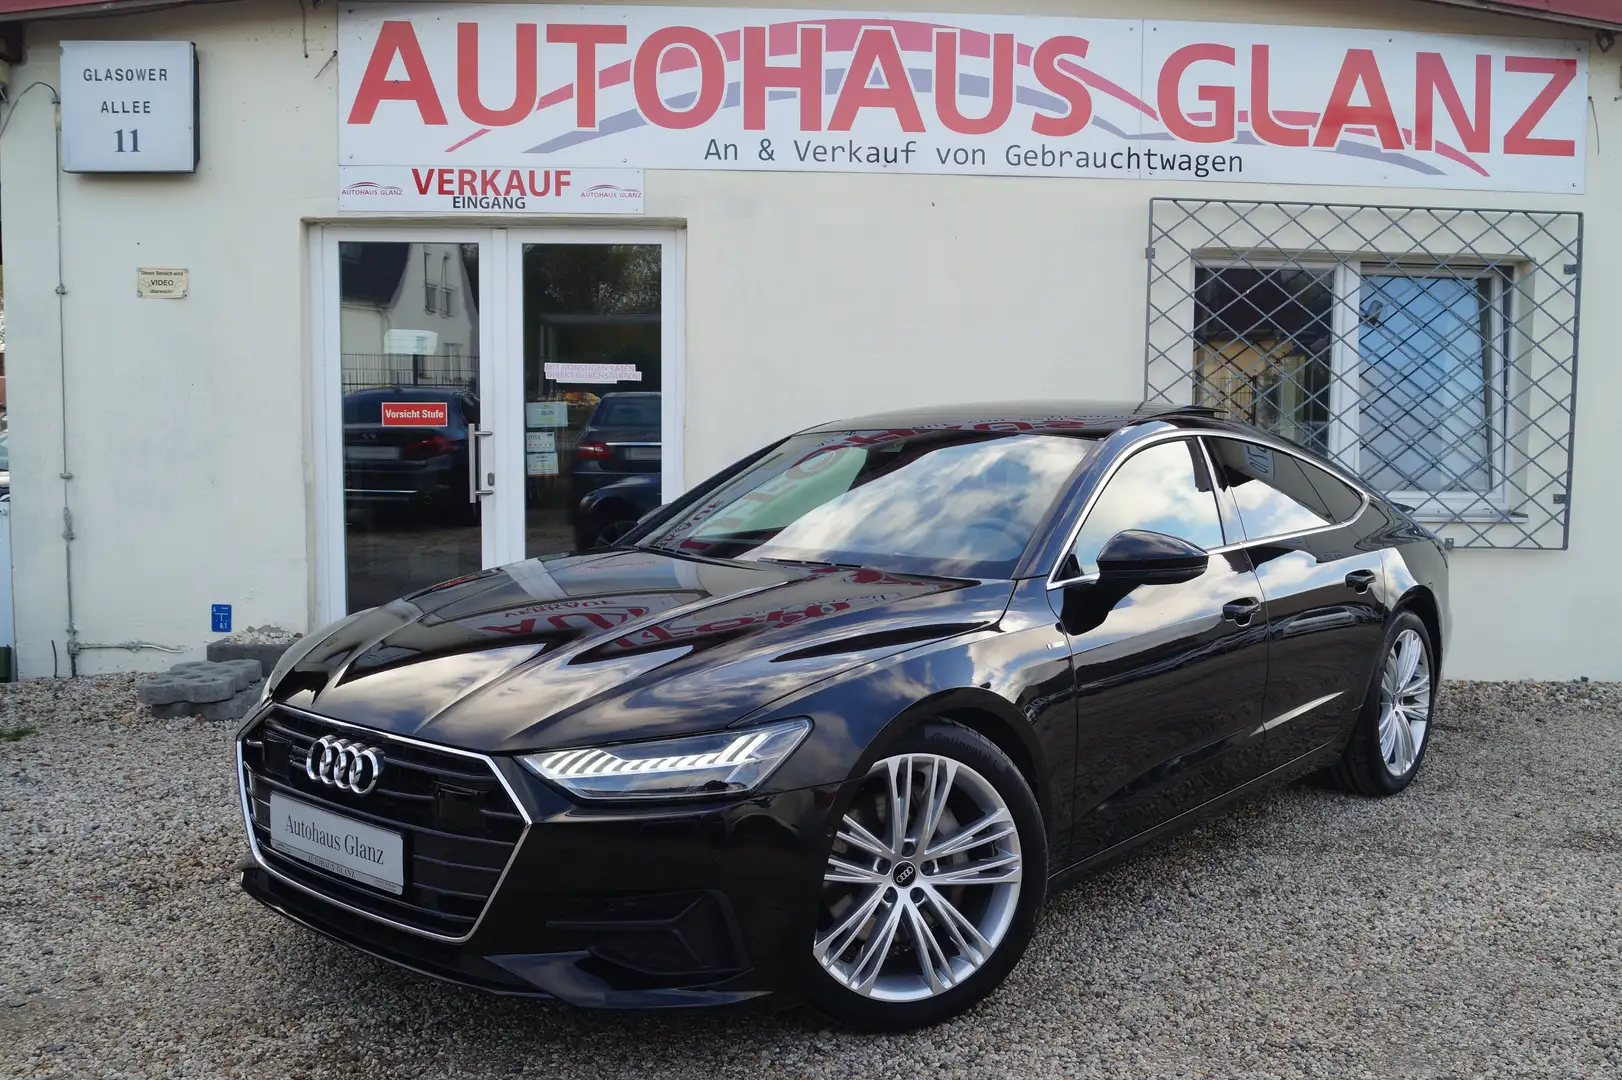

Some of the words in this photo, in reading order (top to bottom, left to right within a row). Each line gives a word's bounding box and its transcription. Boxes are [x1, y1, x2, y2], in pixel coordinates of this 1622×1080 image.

[83, 68, 168, 81] GLASOWER
[346, 20, 1093, 137] AUTOHAUS
[1157, 42, 1577, 157] GLANZ
[100, 101, 151, 114] ALLEE
[113, 128, 141, 153] 11
[704, 138, 739, 161] An
[757, 138, 776, 162] &
[793, 139, 916, 165] Verkauf
[936, 146, 986, 166] von
[1005, 143, 1243, 177] Gebrauchtwagen
[411, 168, 571, 197] VERKAUF
[453, 196, 526, 209] EINGANG
[385, 409, 420, 418] Vorsicht
[422, 409, 443, 418] Stufe
[285, 813, 341, 851] Autohaus
[344, 833, 384, 865] Glanz
